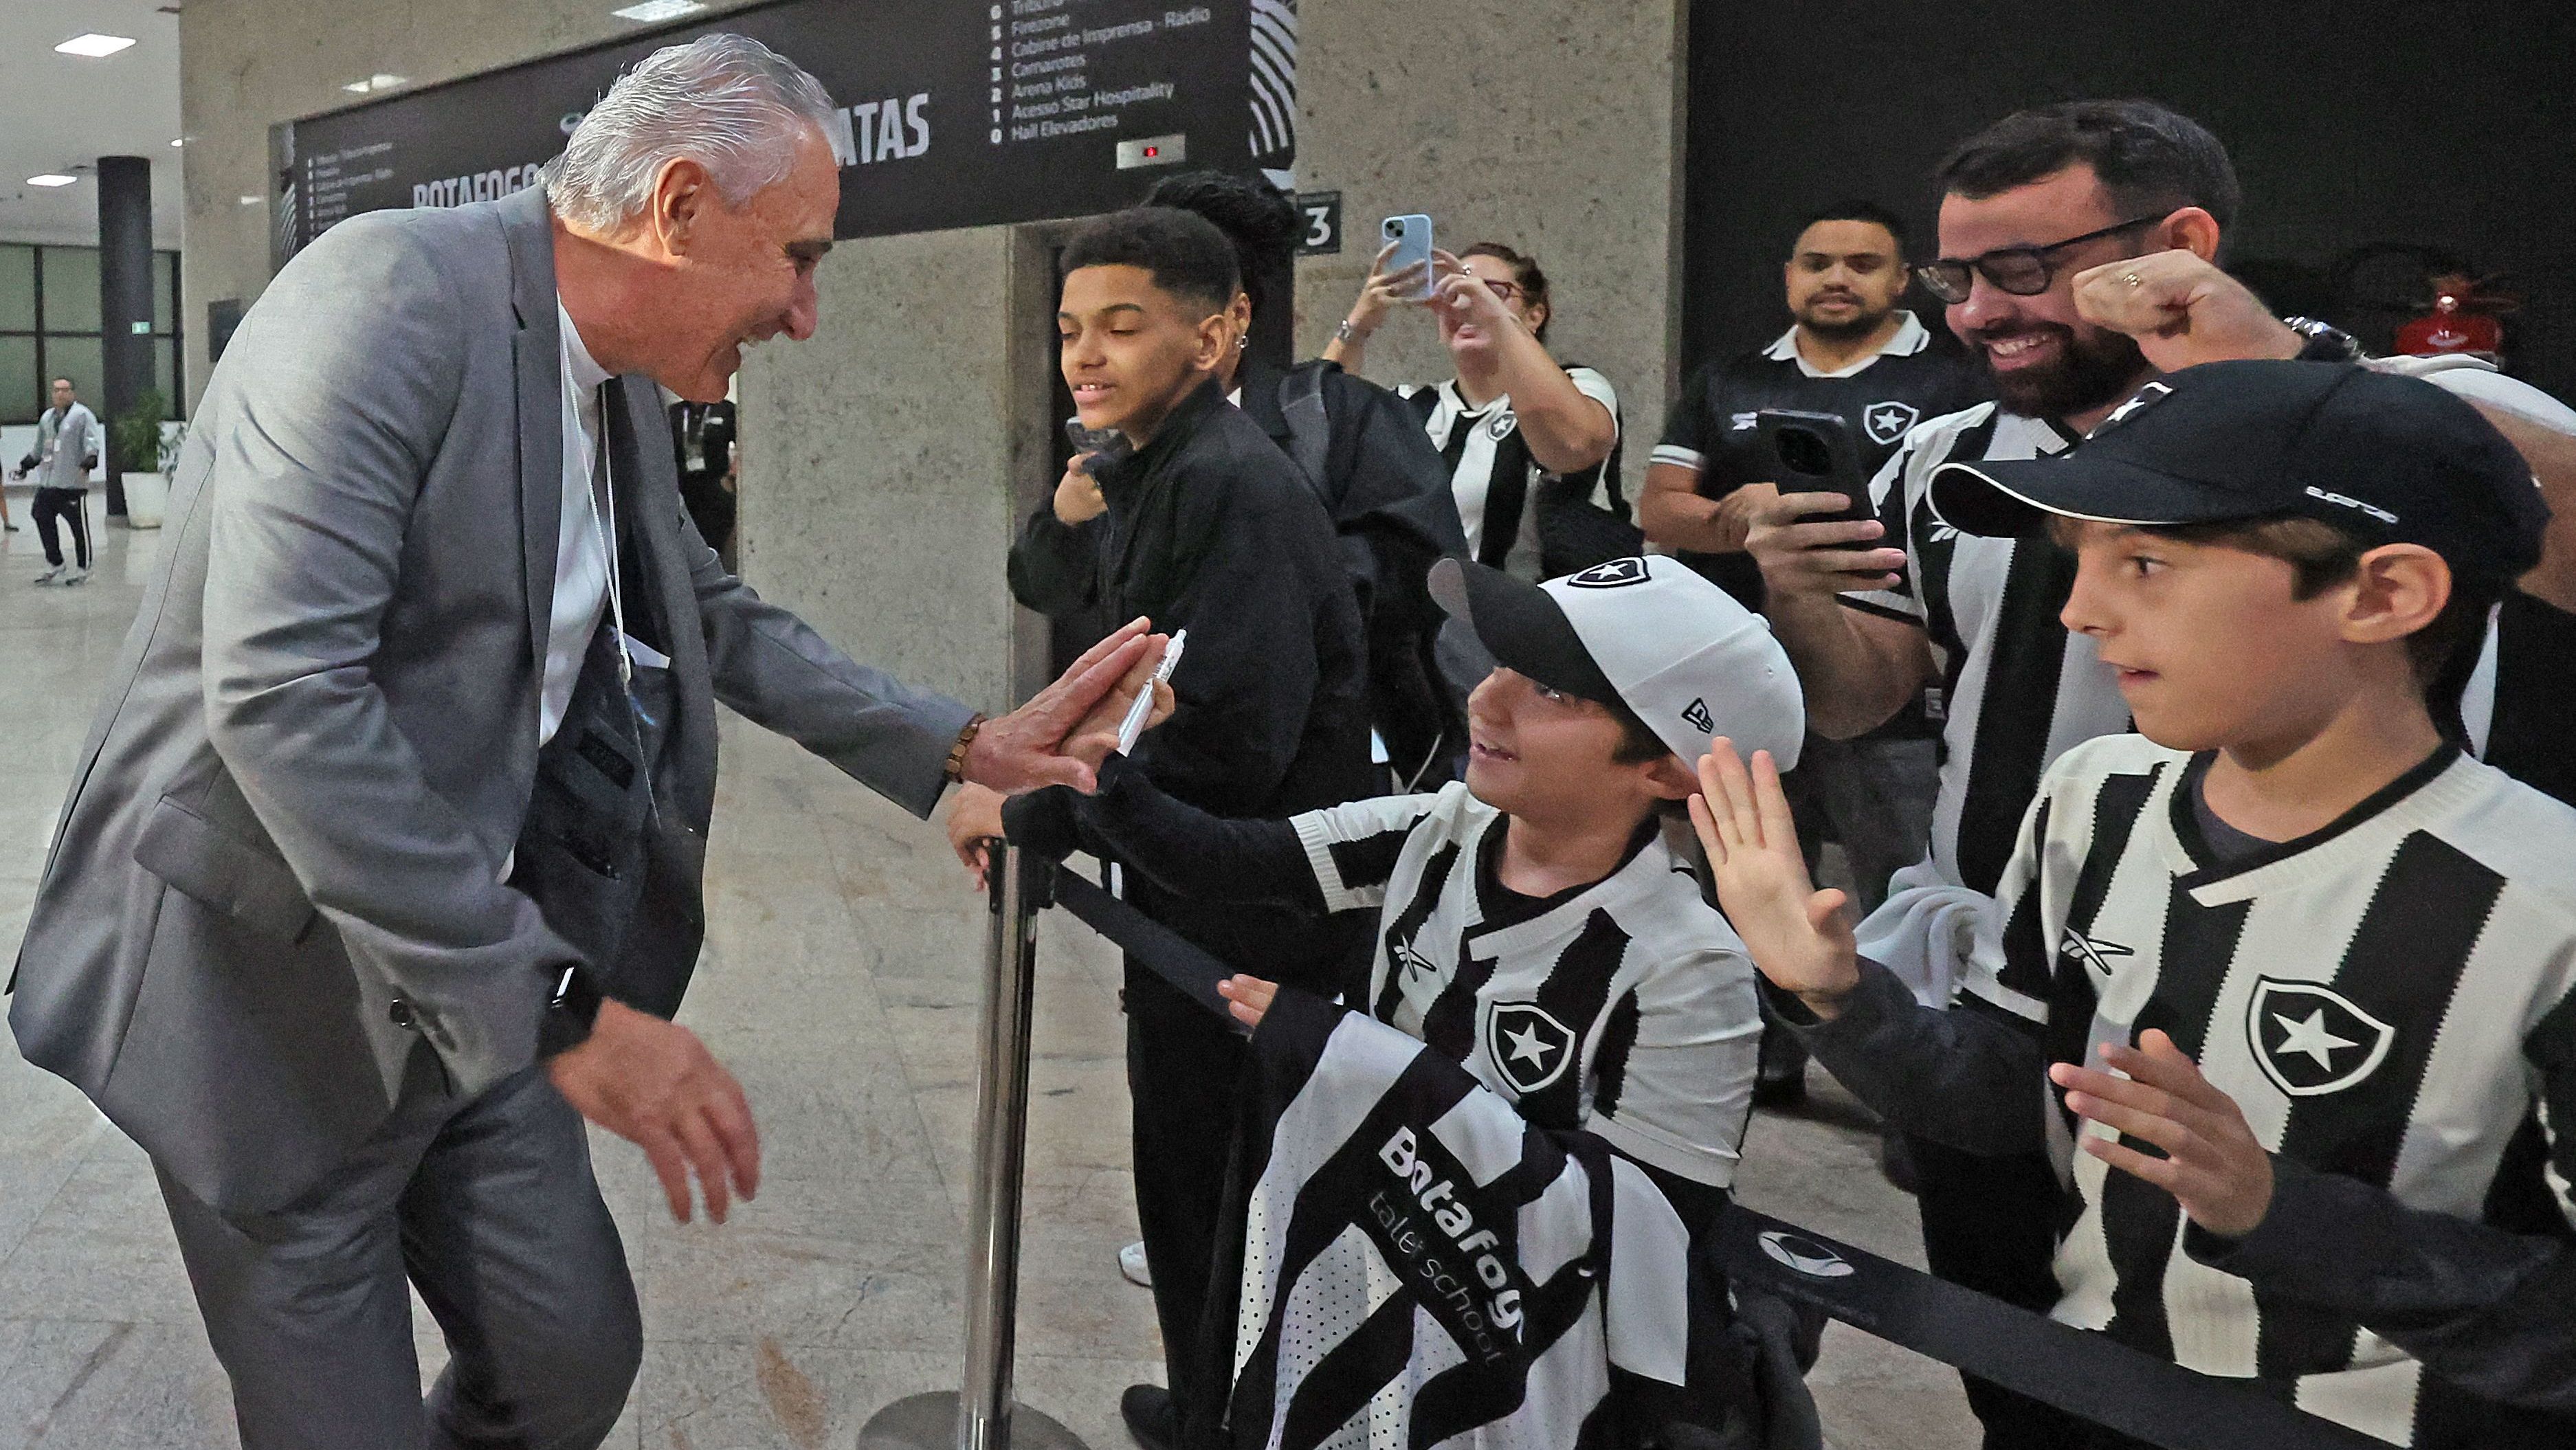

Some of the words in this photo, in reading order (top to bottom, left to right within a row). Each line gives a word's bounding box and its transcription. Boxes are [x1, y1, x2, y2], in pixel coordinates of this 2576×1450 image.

[1012, 38, 1058, 57] Cabine
[1062, 32, 1080, 47] de
[1082, 21, 1153, 44] Imprensa
[1012, 54, 1086, 78] Camarotes
[992, 109, 1001, 122] 1
[1012, 102, 1061, 119] Acesso
[1063, 96, 1091, 112] Star
[1093, 82, 1174, 107] Hospitality
[1012, 82, 1053, 100] Arena
[1054, 74, 1087, 91] Kids
[990, 128, 1002, 144] 0
[1012, 123, 1039, 140] Hall
[1040, 115, 1118, 137] Elevadores
[1306, 206, 1331, 246] 3
[1379, 1125, 1523, 1345] Botafog
[1420, 1259, 1502, 1366] school
